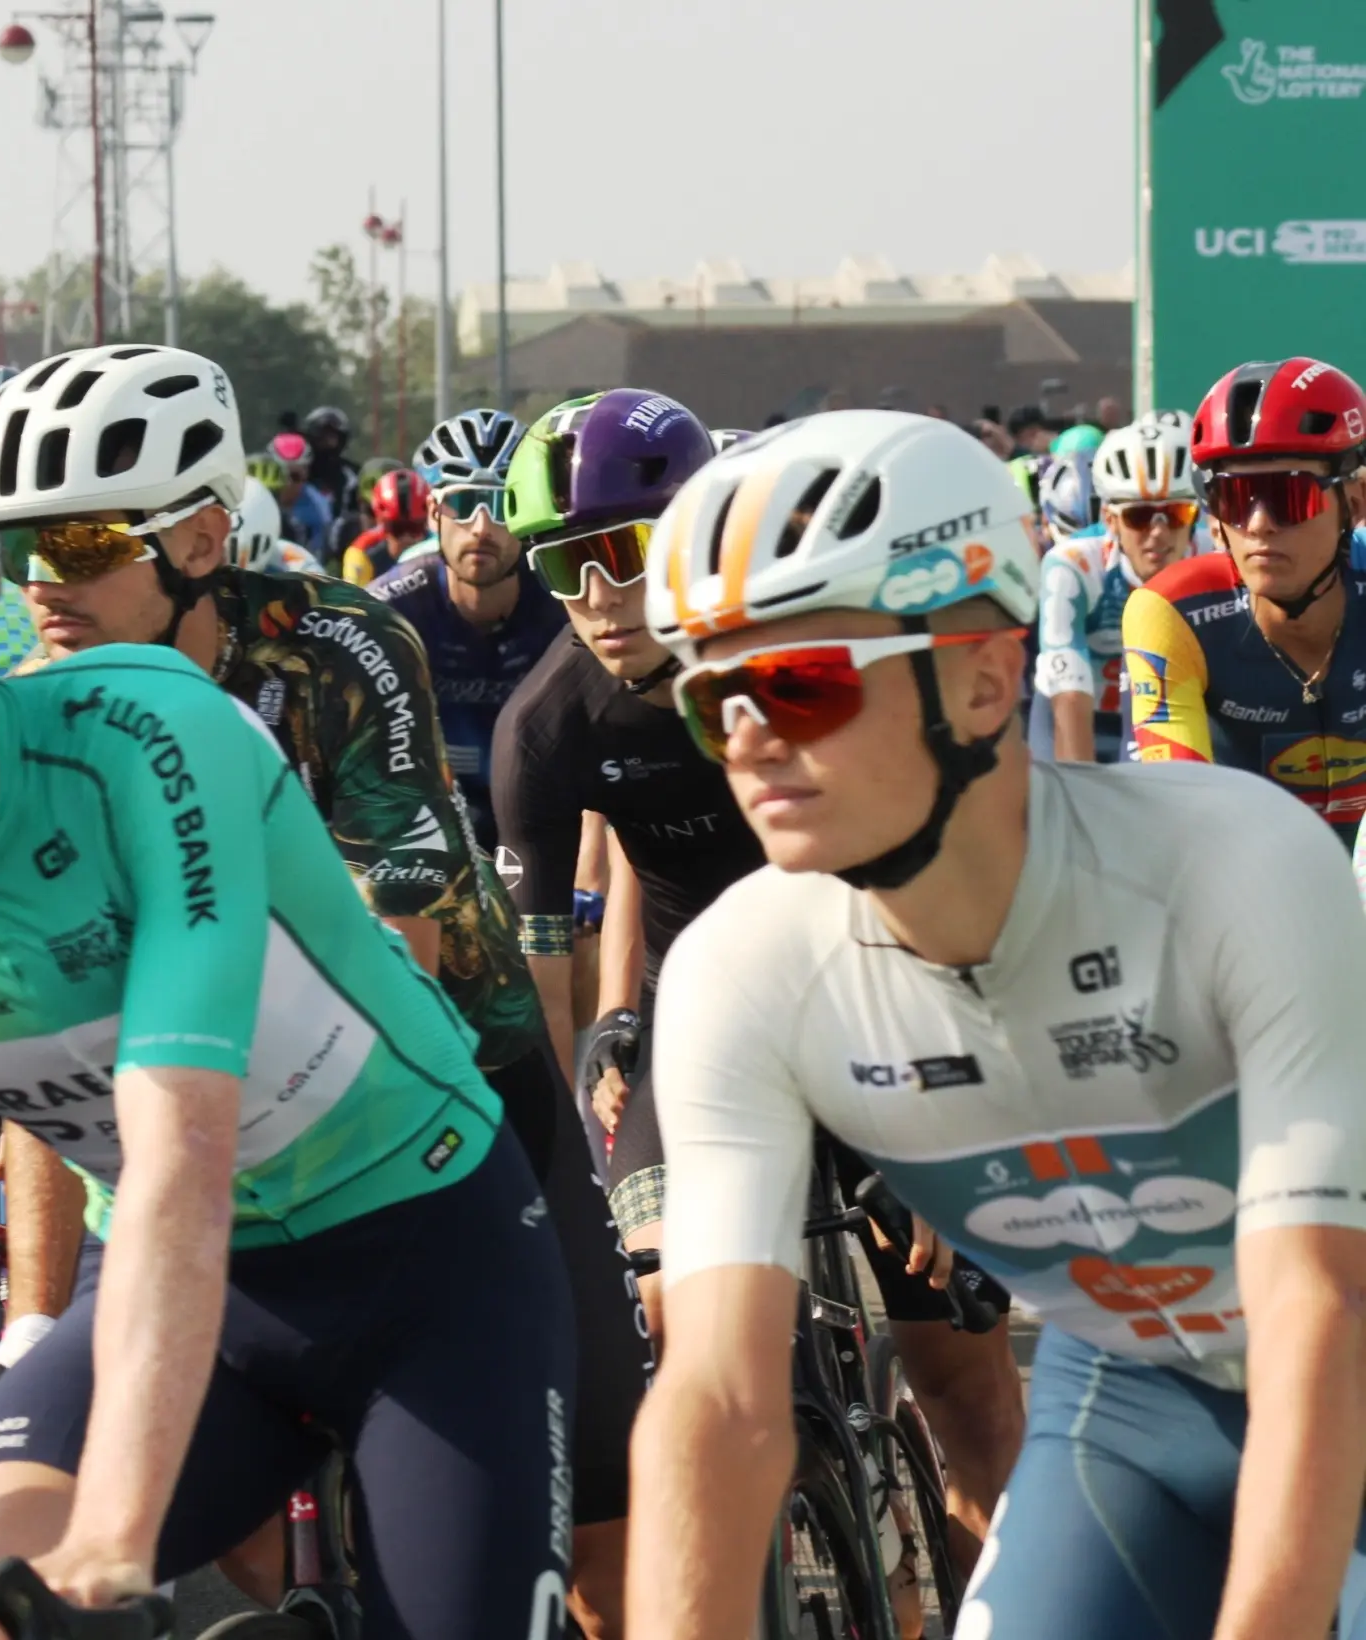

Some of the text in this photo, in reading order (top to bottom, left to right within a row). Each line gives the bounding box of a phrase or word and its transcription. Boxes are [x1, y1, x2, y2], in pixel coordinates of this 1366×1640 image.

[1277, 65, 1366, 79] NATIONA
[1195, 227, 1266, 256] UCI
[889, 507, 991, 554] SCOTT
[1186, 594, 1251, 627] TREK
[384, 692, 416, 773] Mind
[104, 697, 219, 930] LLOYDS BANK
